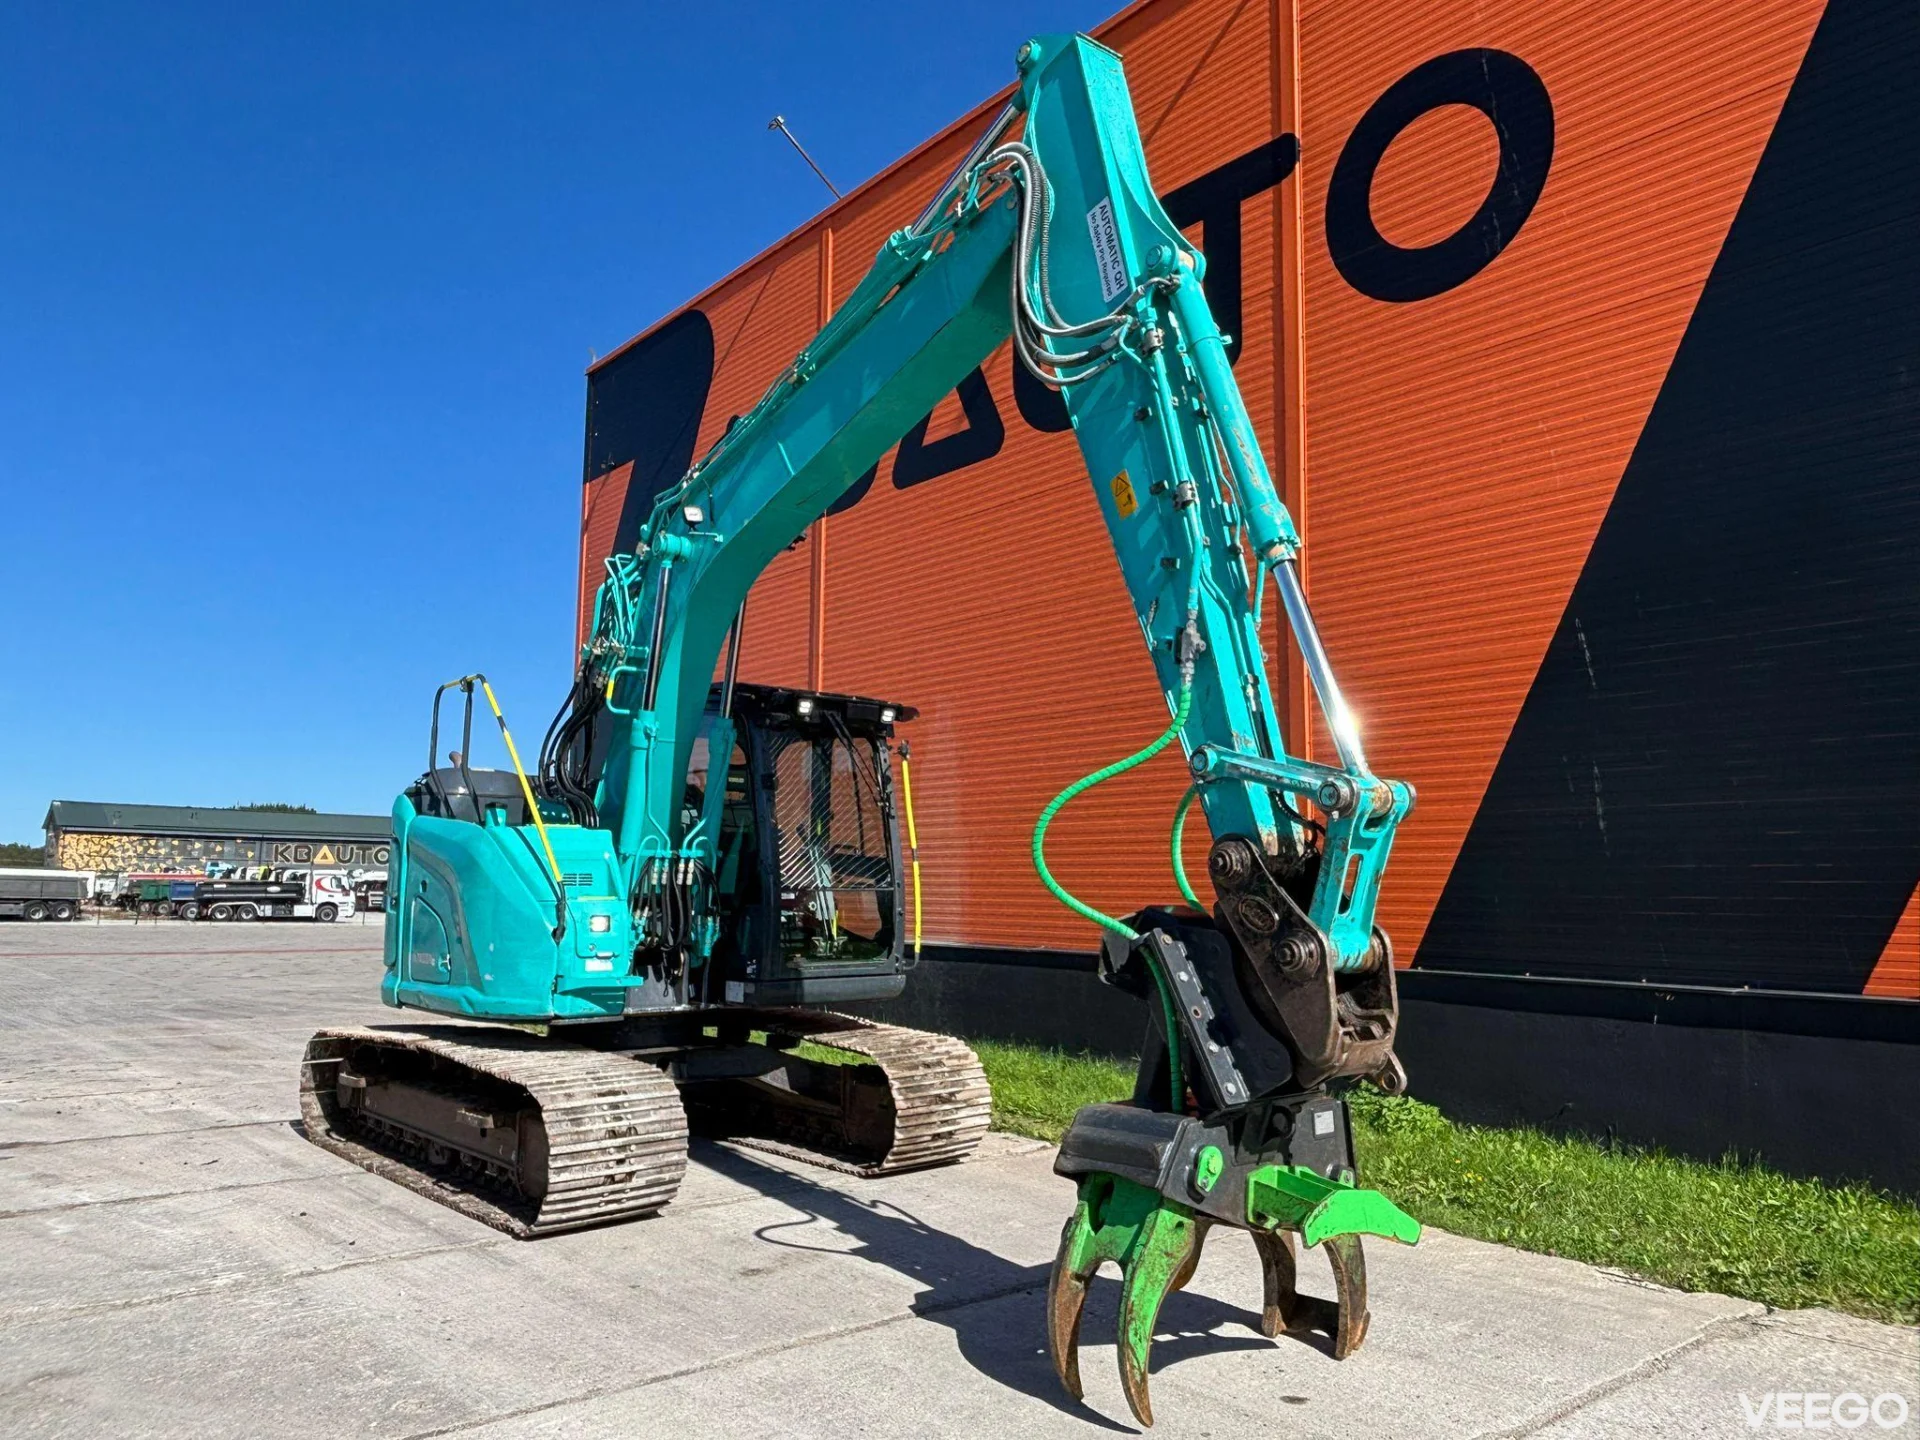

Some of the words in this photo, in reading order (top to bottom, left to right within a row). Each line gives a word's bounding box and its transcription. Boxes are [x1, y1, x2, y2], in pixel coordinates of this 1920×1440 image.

[1091, 212, 1097, 225] No
[1093, 223, 1102, 249] Safety
[1099, 204, 1120, 270] AUTOMATIC
[1114, 270, 1125, 291] QH
[1101, 261, 1112, 297] Required
